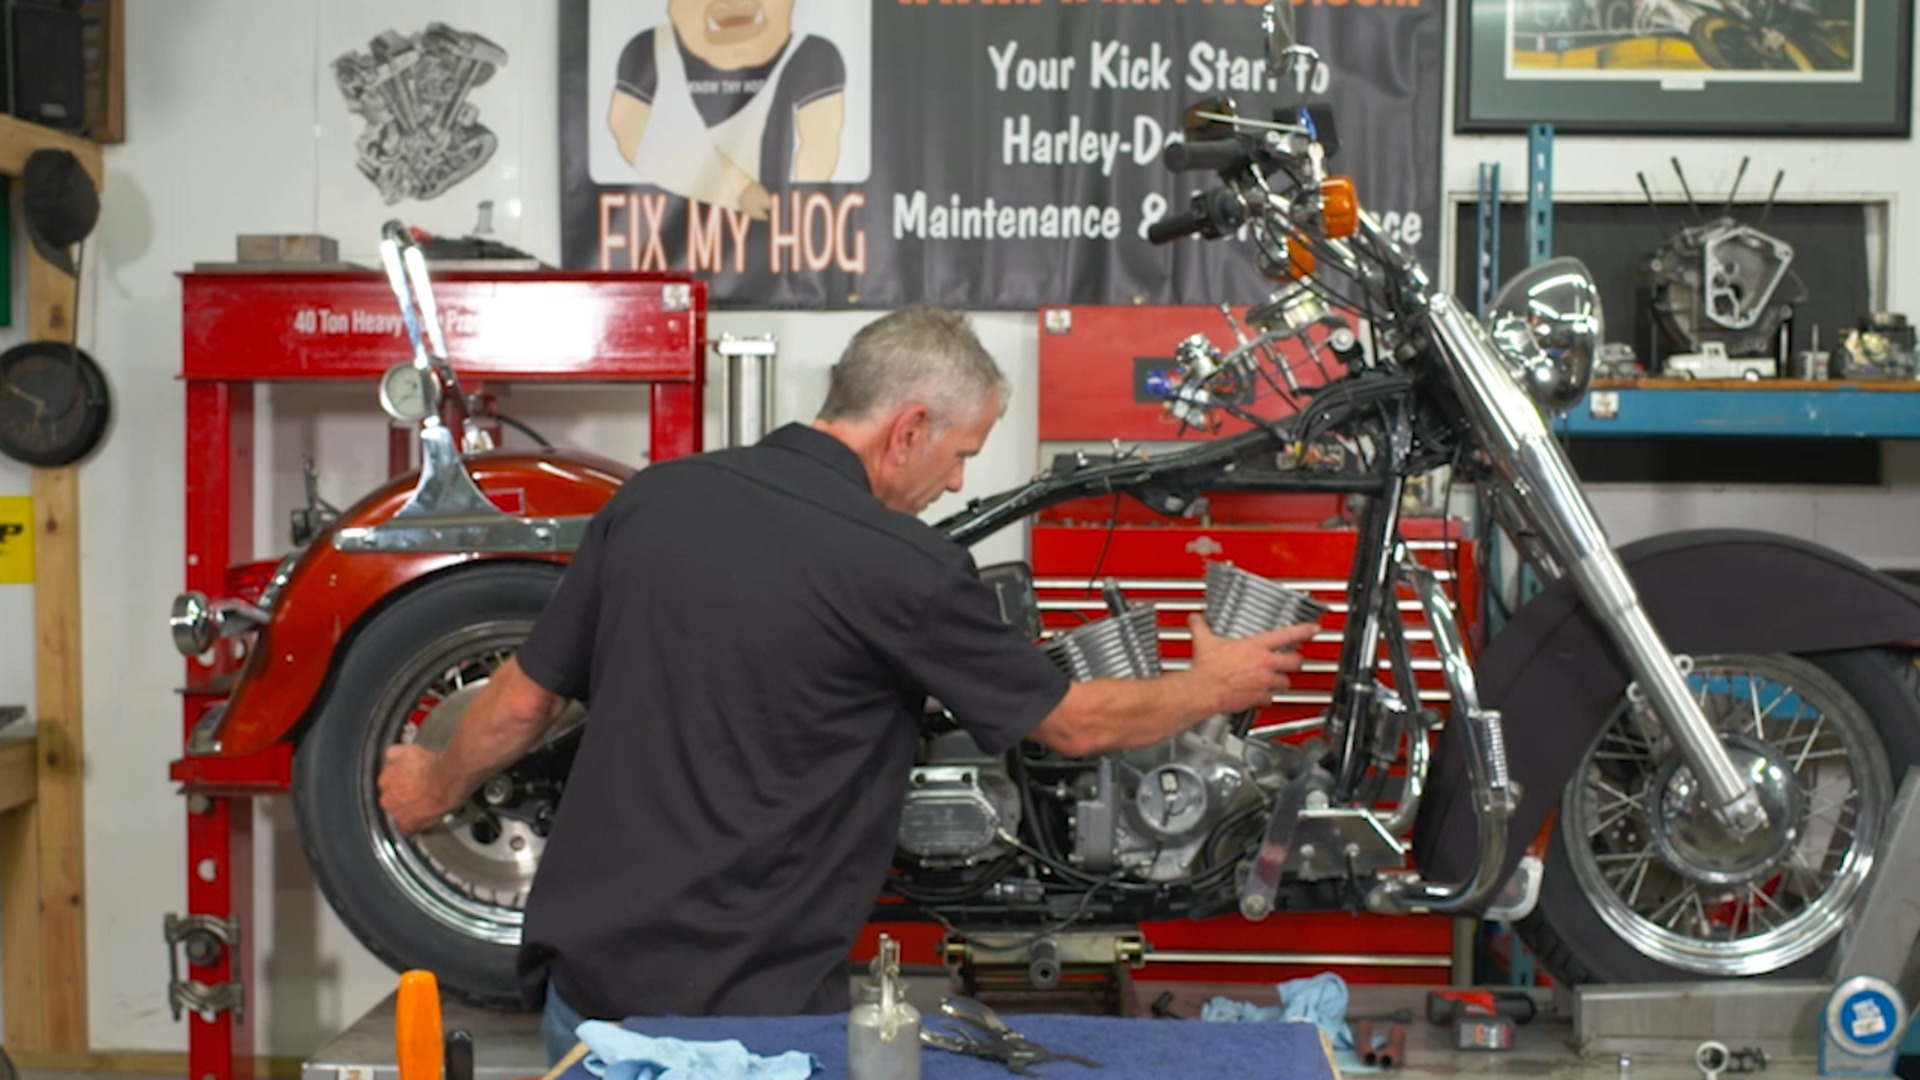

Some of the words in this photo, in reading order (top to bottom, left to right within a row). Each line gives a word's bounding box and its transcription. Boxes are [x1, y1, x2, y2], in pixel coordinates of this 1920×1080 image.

[987, 40, 1075, 91] Your
[1090, 40, 1172, 91] Kick
[1186, 40, 1278, 93] Star
[1293, 50, 1330, 94] to
[599, 192, 667, 272] FIX
[686, 196, 752, 274] MY
[769, 189, 866, 275] HOG
[893, 191, 1121, 240] Maintenance
[294, 310, 315, 333] 40
[319, 309, 348, 333] Ton
[352, 310, 401, 338] Heavy
